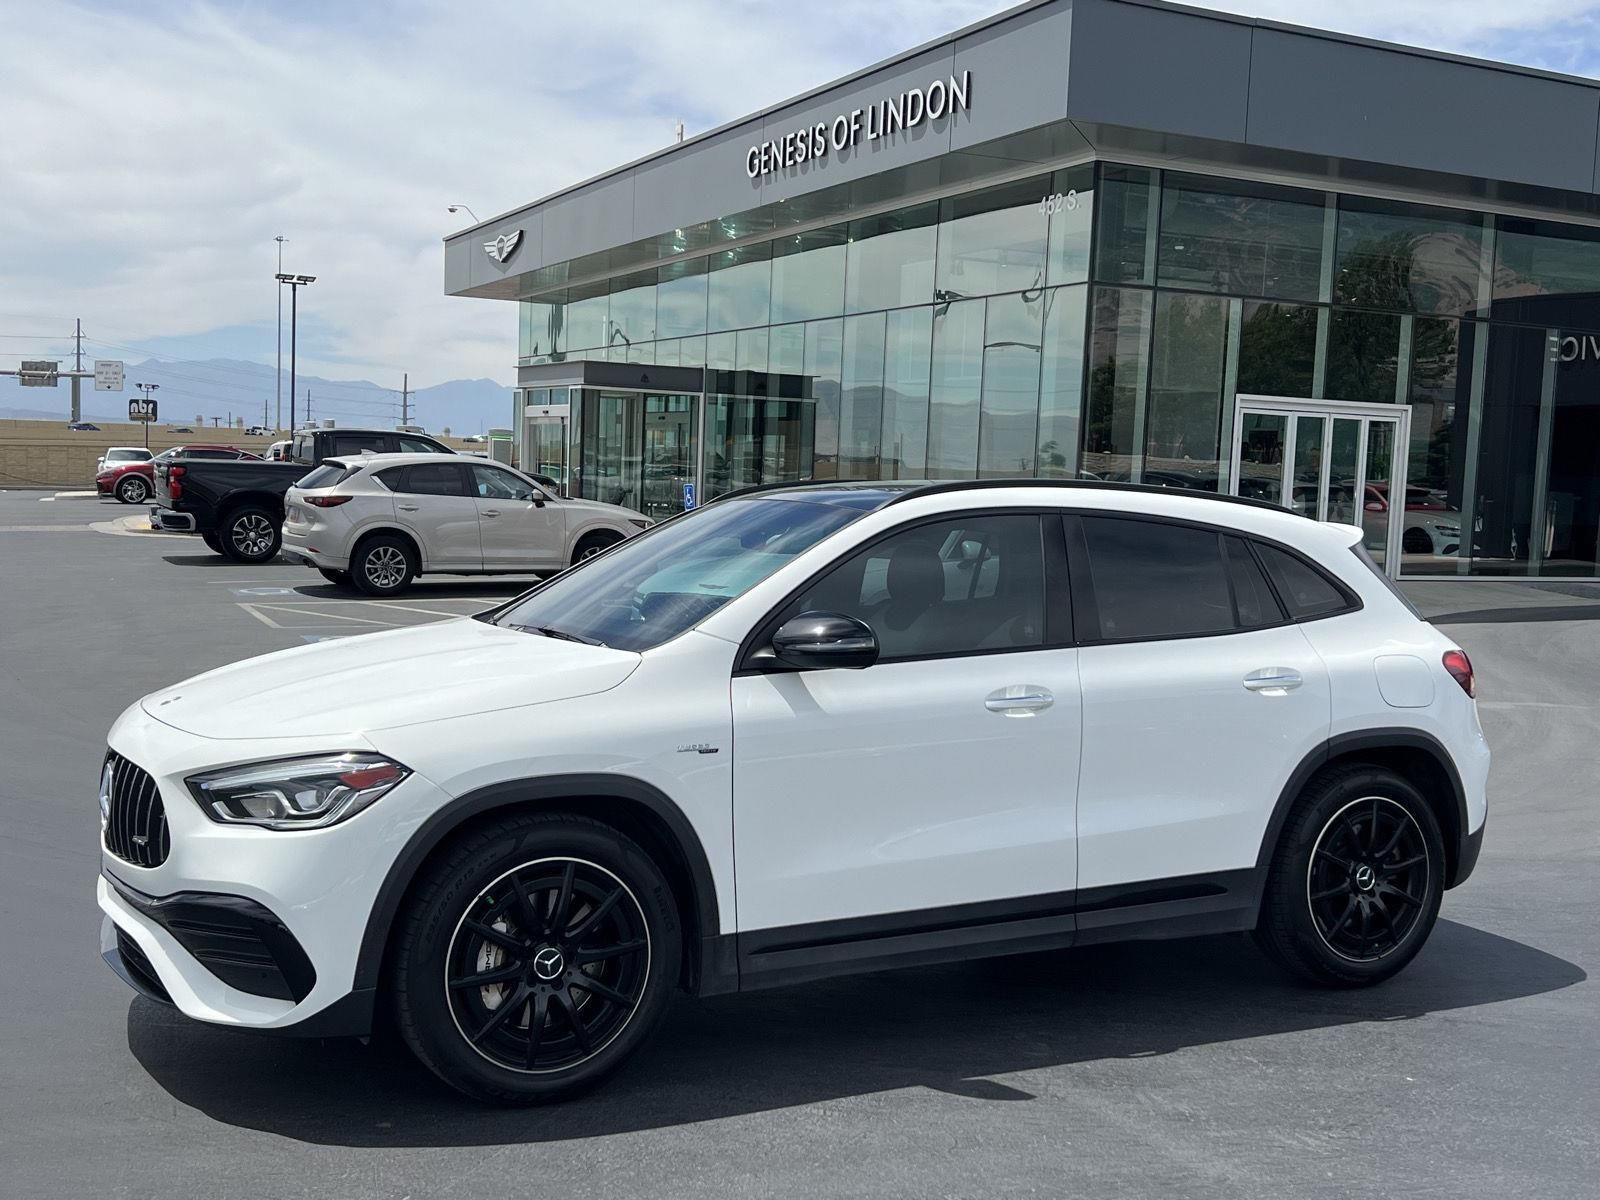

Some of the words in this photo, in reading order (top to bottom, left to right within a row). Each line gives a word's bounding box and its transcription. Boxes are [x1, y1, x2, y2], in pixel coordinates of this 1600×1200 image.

[746, 121, 827, 178] GENESIS
[832, 109, 863, 151] OF
[867, 70, 970, 140] LINDON
[1039, 192, 1063, 216] 452
[1067, 189, 1080, 210] S.
[130, 399, 154, 414] nbr
